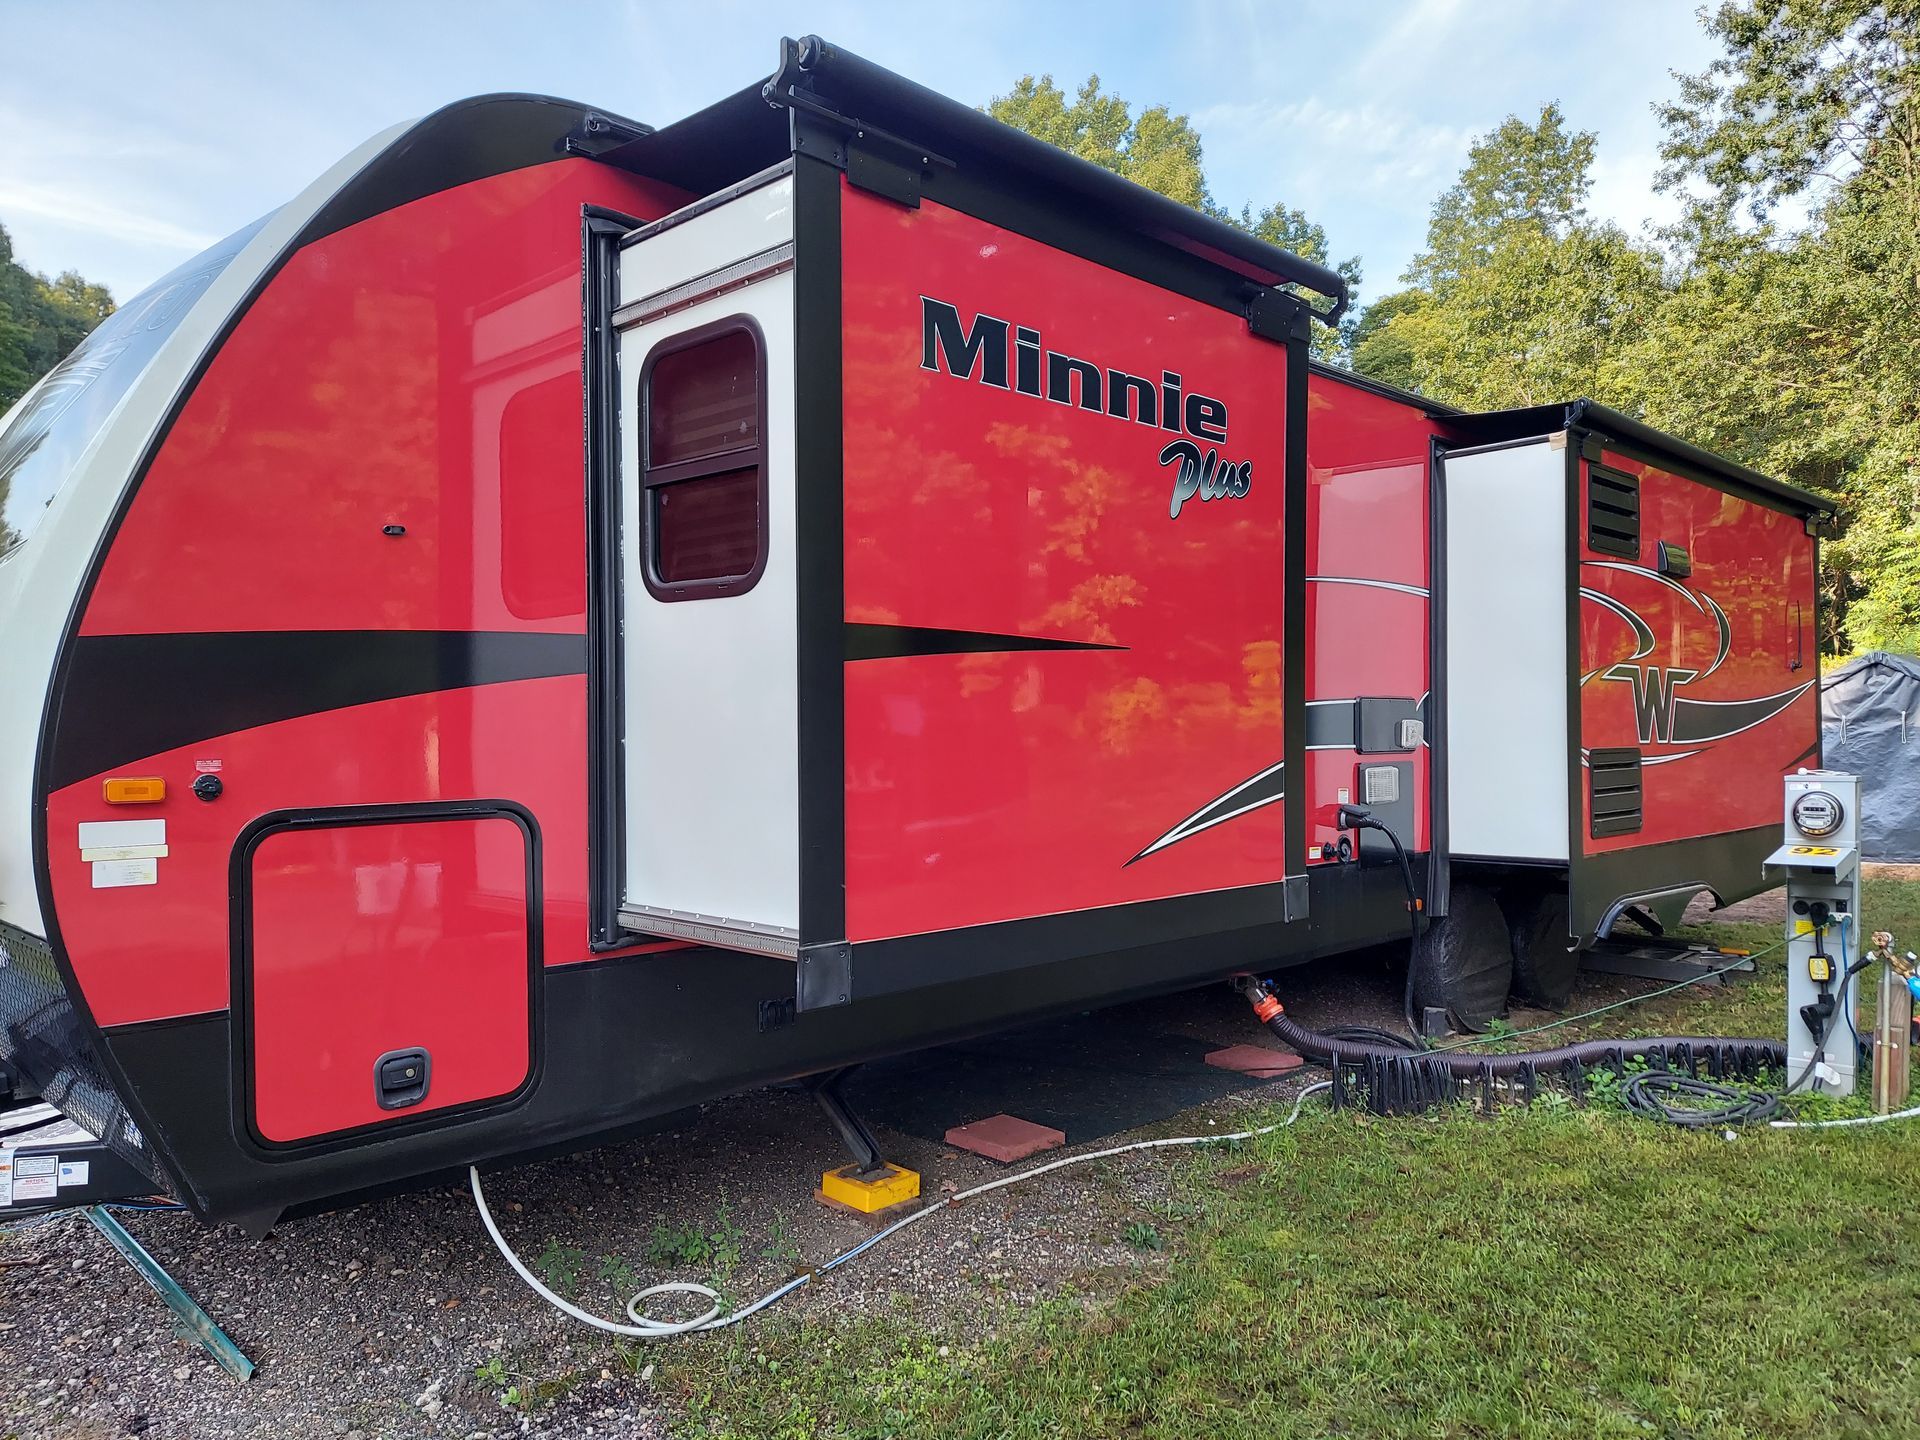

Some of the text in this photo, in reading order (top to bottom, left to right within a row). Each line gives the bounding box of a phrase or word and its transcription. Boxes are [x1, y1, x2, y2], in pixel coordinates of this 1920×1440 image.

[919, 294, 1228, 445] Minnie
[1601, 663, 1700, 744] W
[1791, 847, 1839, 856] 92
